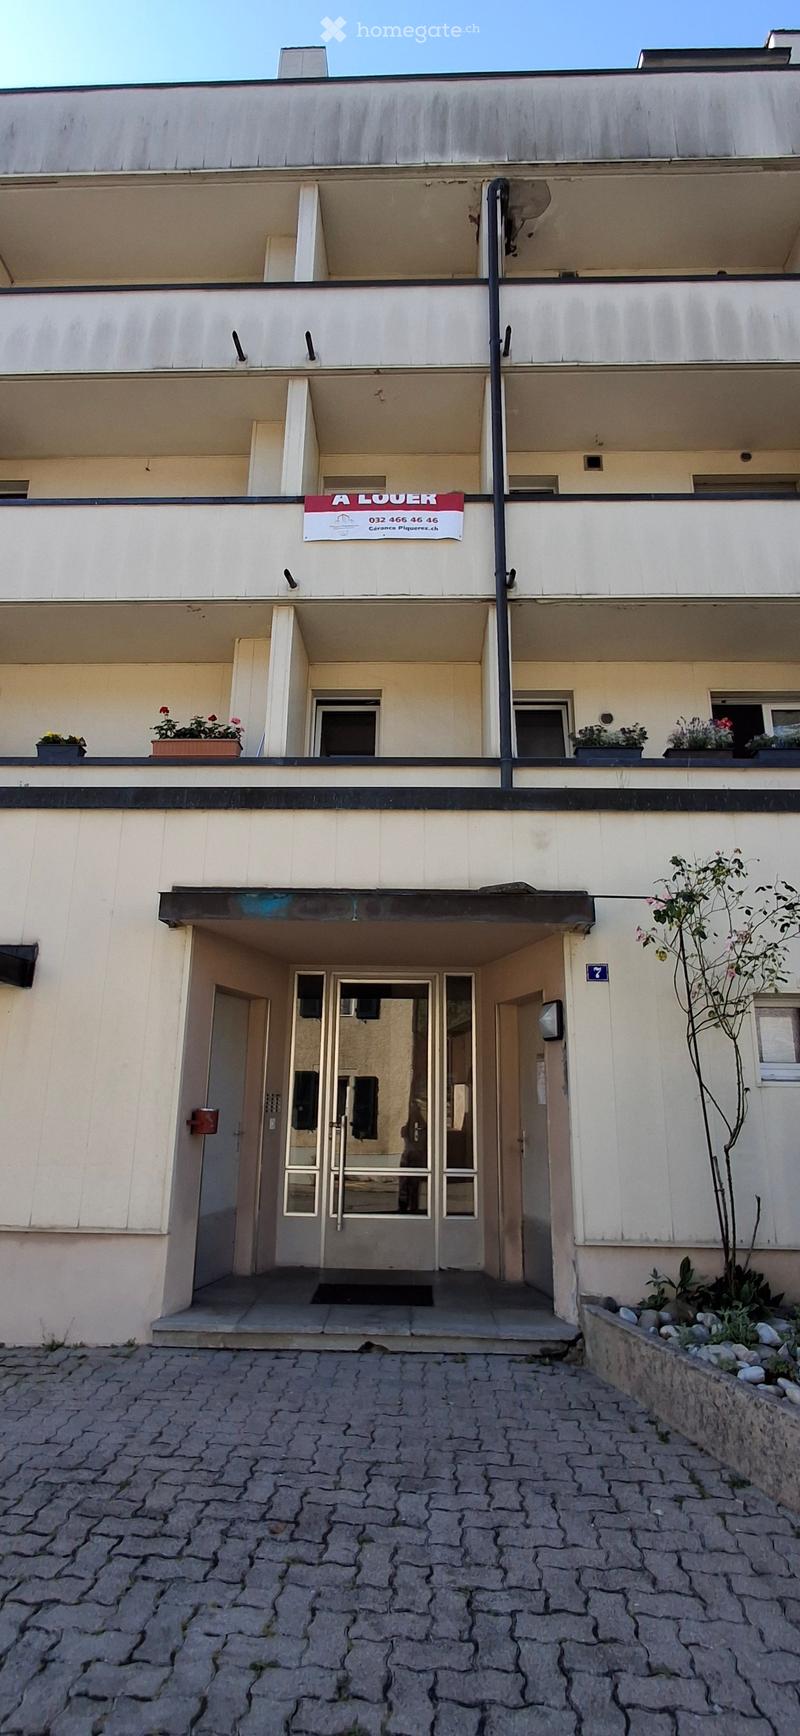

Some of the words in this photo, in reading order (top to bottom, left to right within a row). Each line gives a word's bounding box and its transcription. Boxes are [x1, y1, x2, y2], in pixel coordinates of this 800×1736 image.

[332, 494, 350, 506] A
[358, 493, 437, 505] LOUER
[593, 966, 602, 979] 7
